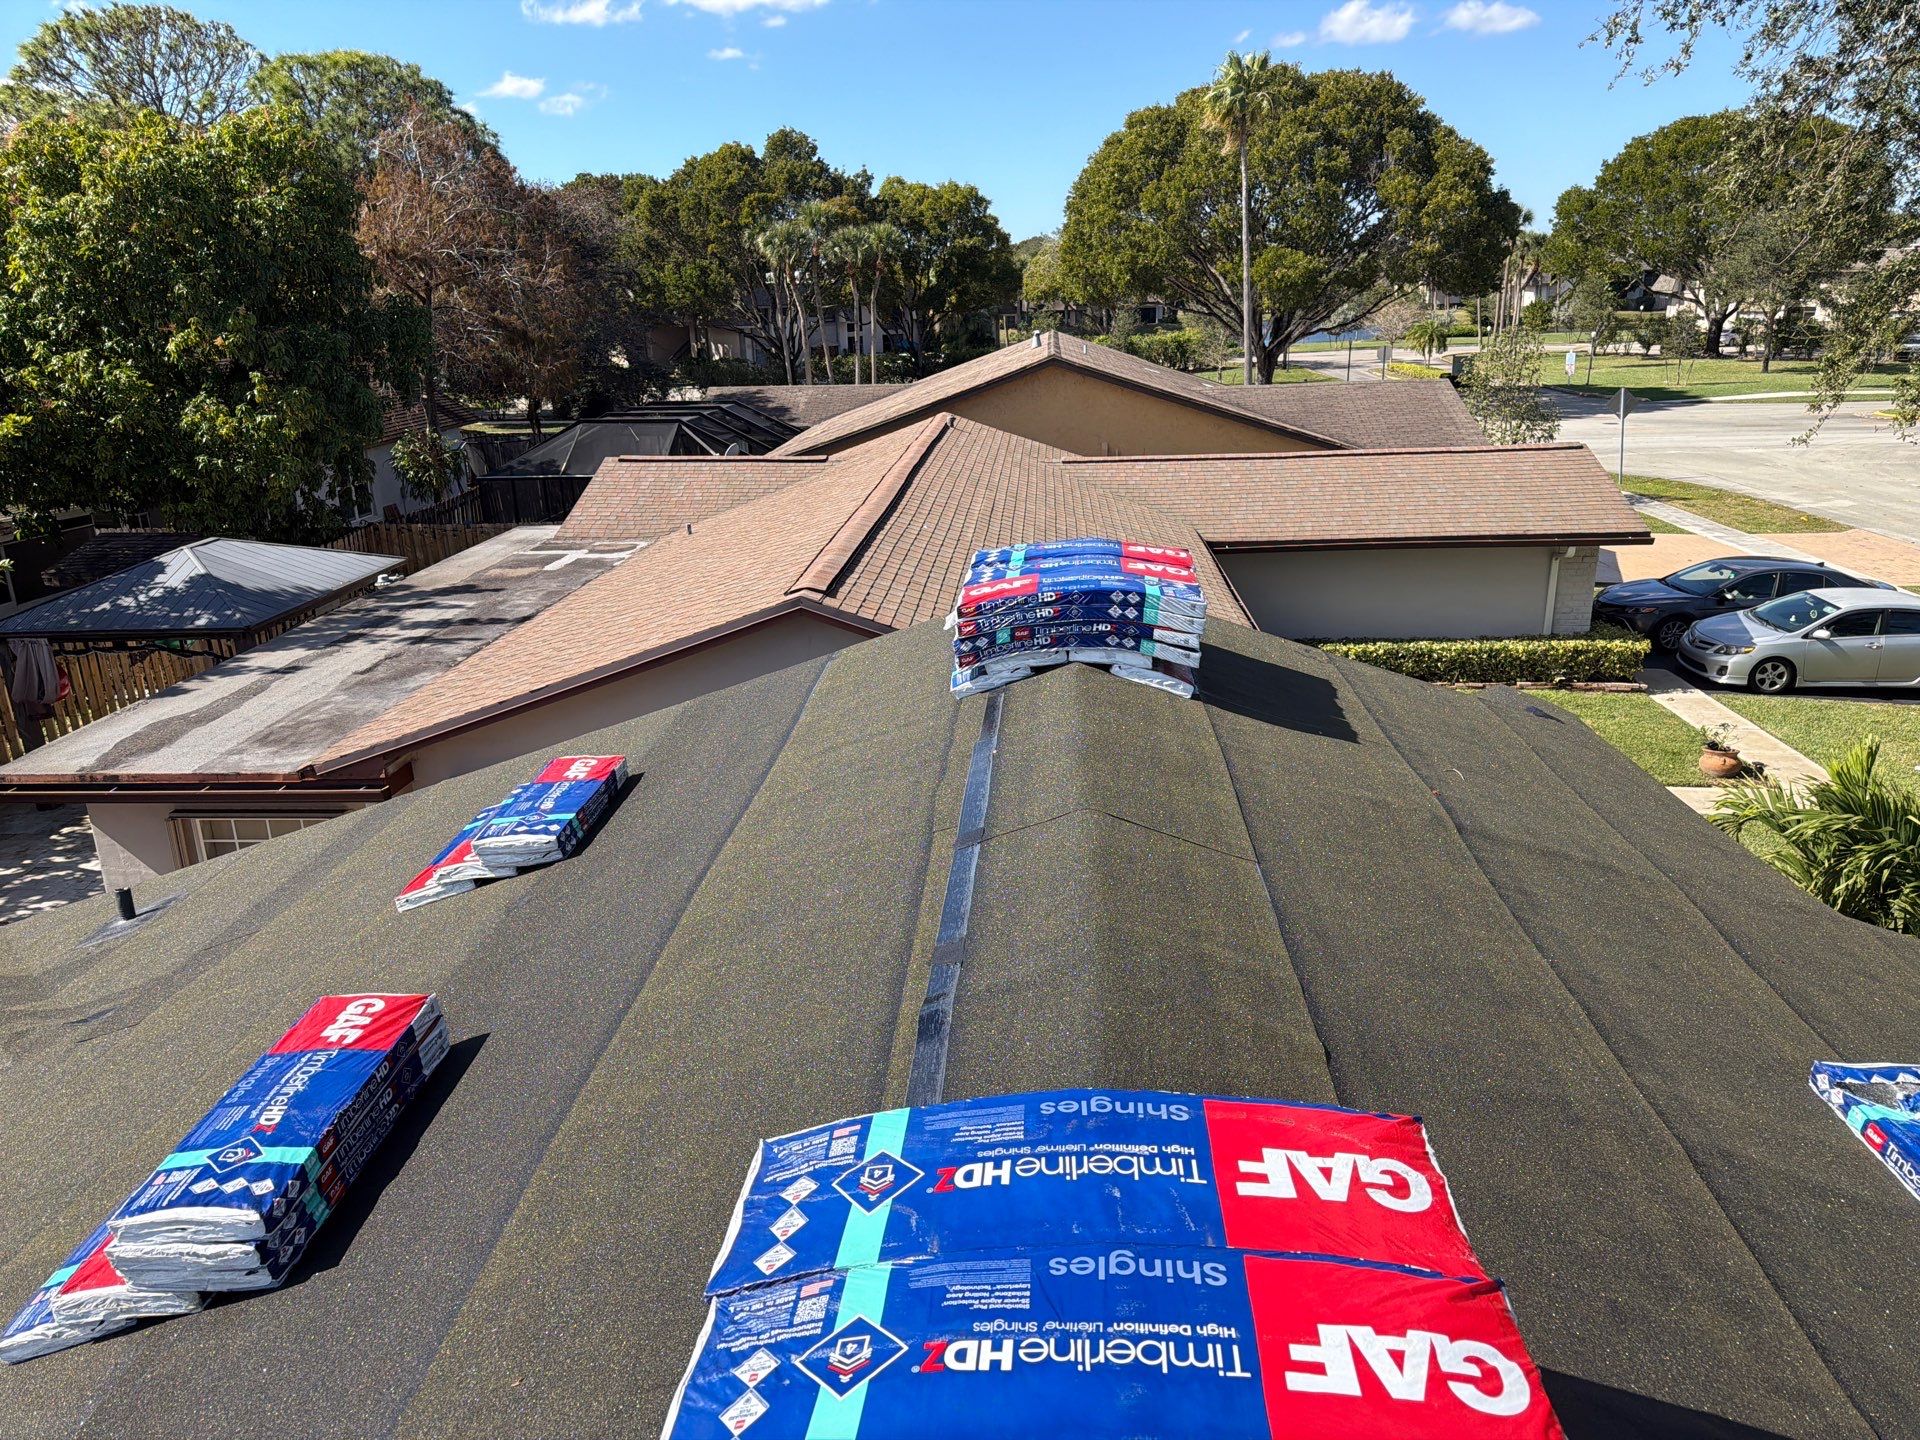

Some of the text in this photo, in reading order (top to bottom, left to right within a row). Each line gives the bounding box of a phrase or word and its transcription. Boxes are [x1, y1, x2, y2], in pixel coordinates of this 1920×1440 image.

[1127, 544, 1190, 558] GAF
[1128, 561, 1190, 576] GAF
[968, 577, 1034, 597] GAF
[564, 758, 599, 780] GAF
[320, 997, 386, 1045] GAF
[1039, 1095, 1190, 1121] Shingles
[1866, 1127, 1883, 1145] GAF
[976, 1145, 1031, 1158] Shingles
[1162, 1144, 1195, 1155] High
[1235, 1147, 1433, 1213] GAF
[1049, 1249, 1228, 1287] Shingles
[973, 1318, 1038, 1333] Shingles
[1196, 1323, 1237, 1338] High
[1285, 1323, 1531, 1416] GAF
